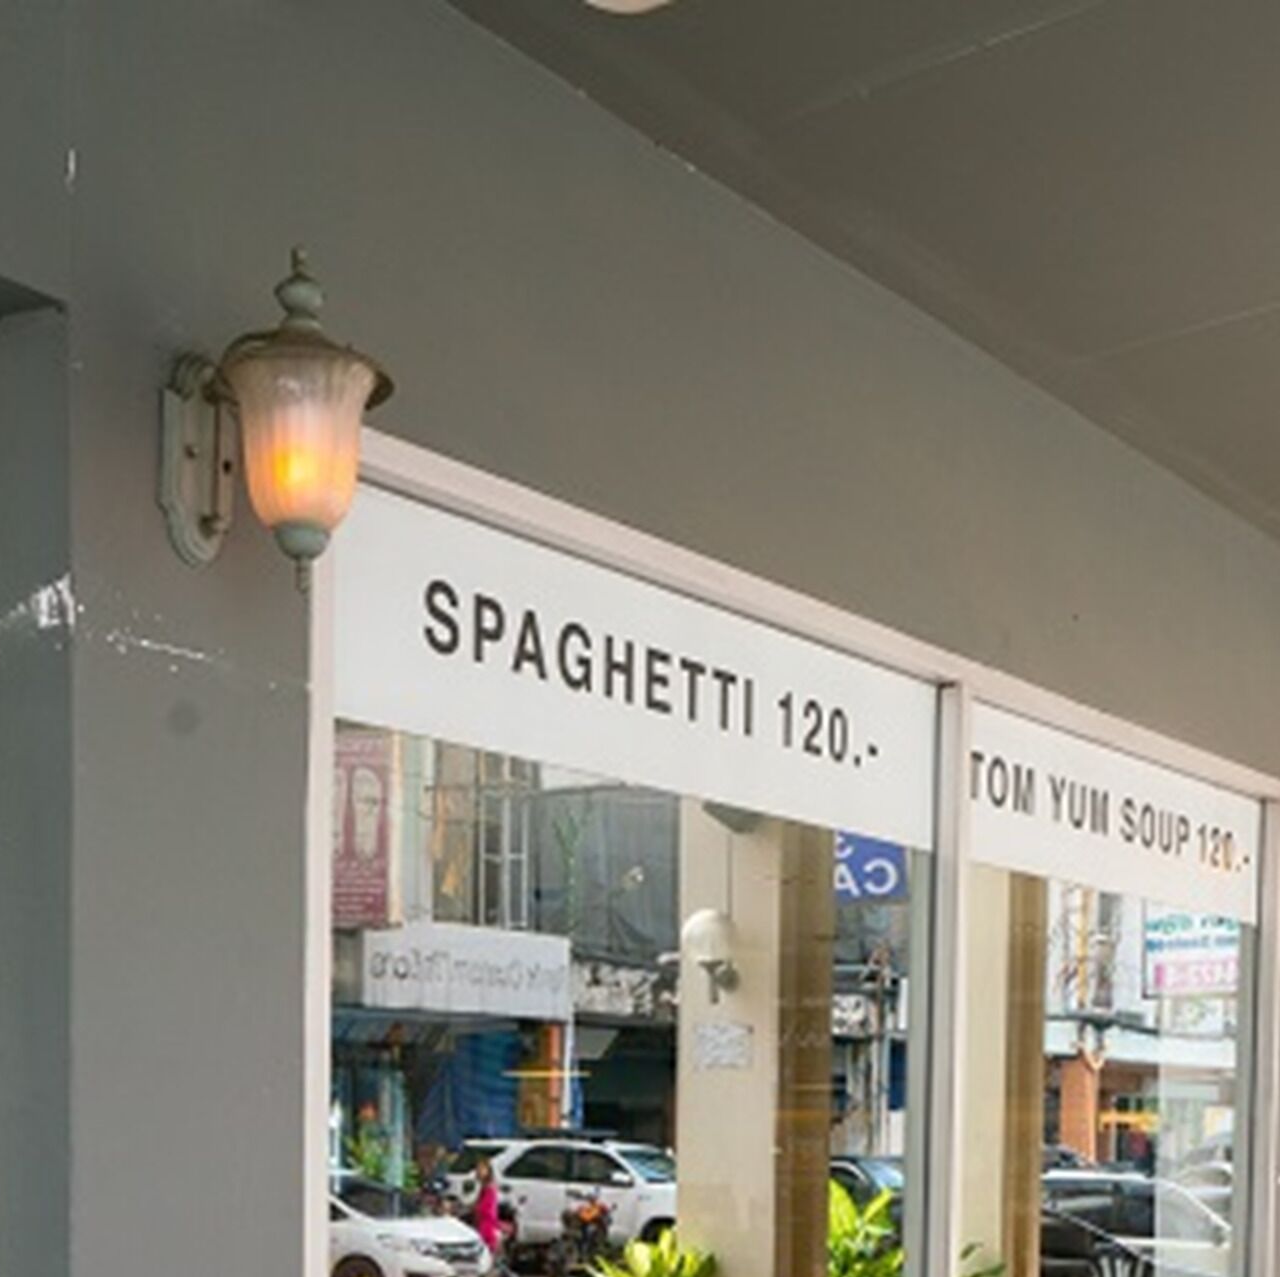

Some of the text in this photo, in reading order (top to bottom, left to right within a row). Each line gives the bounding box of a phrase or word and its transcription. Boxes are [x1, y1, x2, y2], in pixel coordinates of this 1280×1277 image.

[424, 580, 878, 767] SPAGHETTI 120.-
[970, 751, 1251, 873] TOM YUM SOUP 120.-
